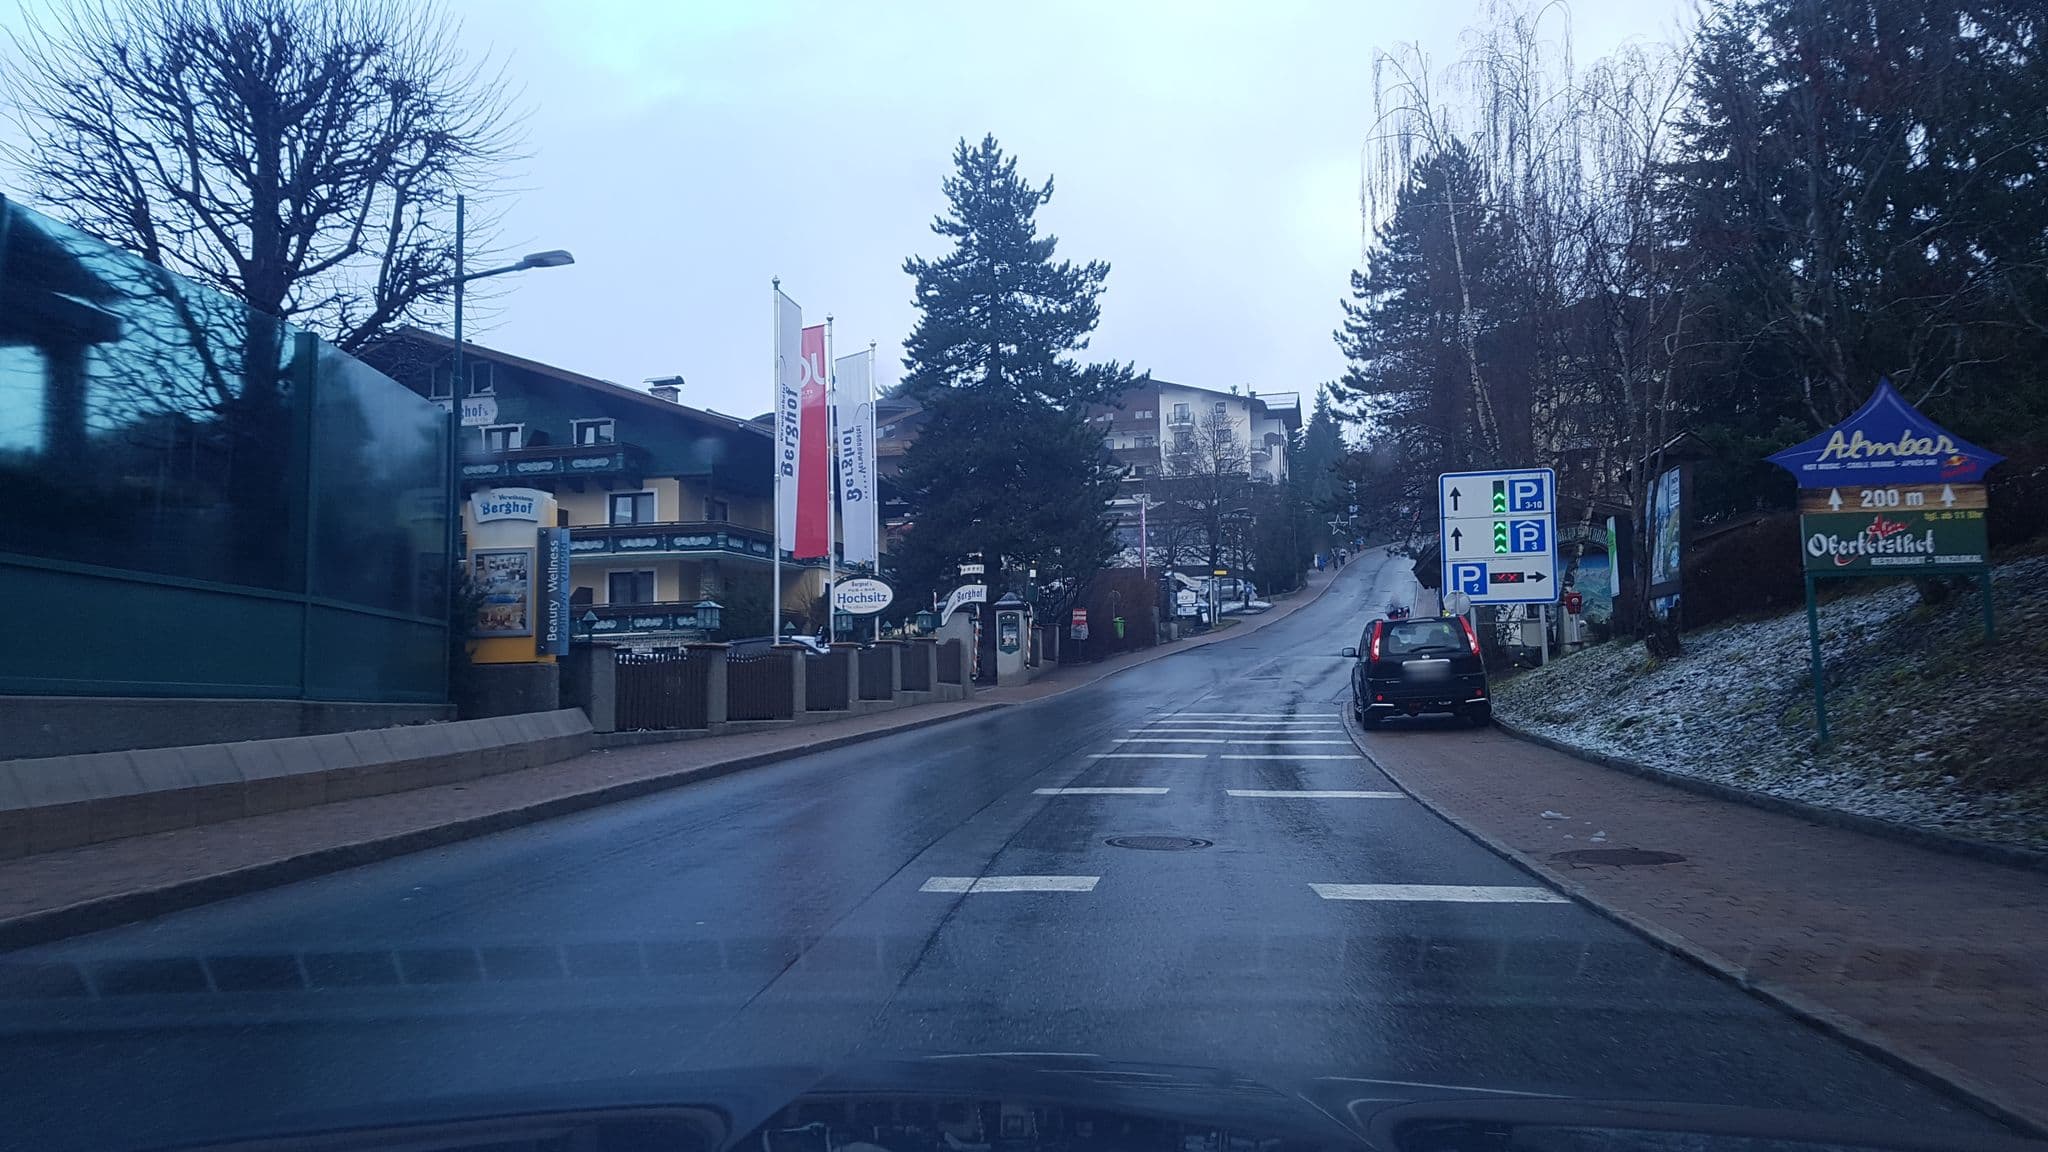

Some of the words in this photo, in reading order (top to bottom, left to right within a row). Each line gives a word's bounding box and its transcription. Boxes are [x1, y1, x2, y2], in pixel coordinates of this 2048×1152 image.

[781, 388, 799, 477] Berghof
[1816, 429, 1959, 462] Almbar
[1515, 481, 1538, 510] P
[1525, 501, 1543, 509] 3-10
[1861, 489, 1899, 507] 200
[1905, 492, 1924, 506] m
[480, 501, 533, 516] Berghof
[1520, 527, 1539, 551] P
[1531, 542, 1538, 550] 3
[547, 539, 559, 593] Wellness
[1458, 565, 1481, 593] P
[1473, 584, 1480, 592] 2
[837, 592, 888, 604] Hochsitz
[547, 600, 560, 641] Beauty
